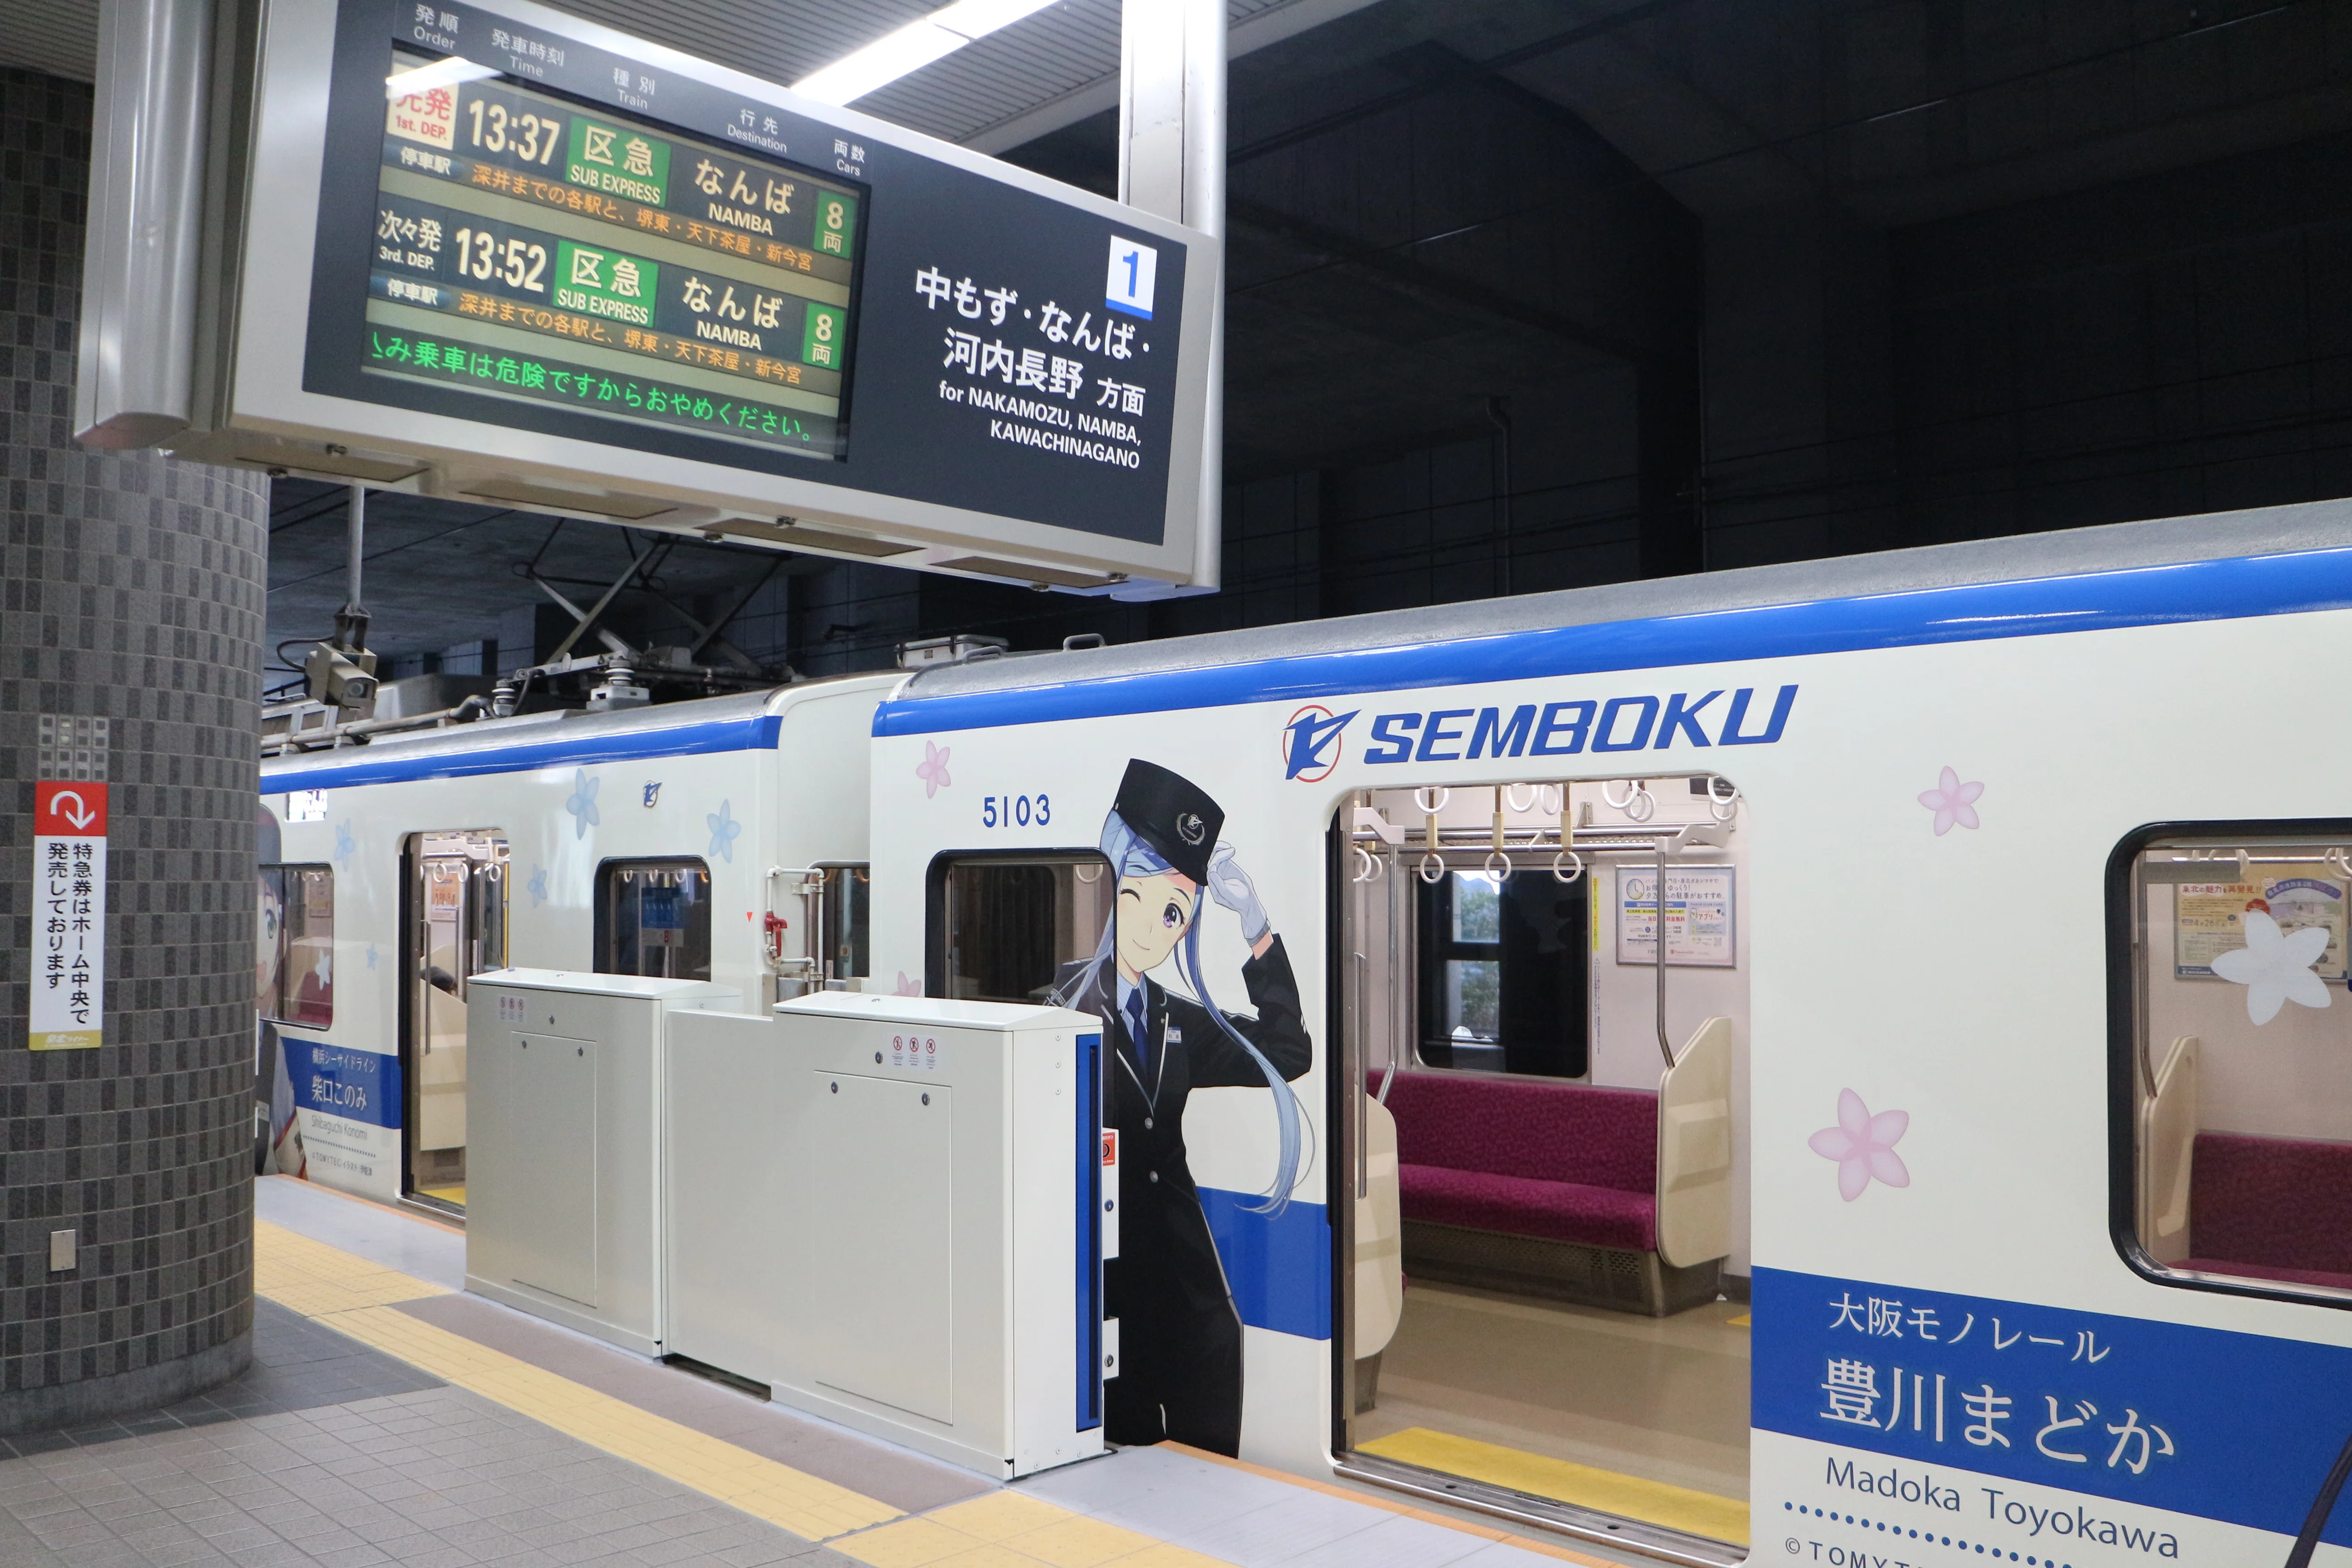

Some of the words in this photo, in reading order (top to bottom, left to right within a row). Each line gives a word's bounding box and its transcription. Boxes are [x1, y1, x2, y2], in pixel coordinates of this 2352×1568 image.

[415, 4, 458, 34] 発順
[414, 26, 455, 50] Order
[491, 29, 564, 67] 発車時刻
[510, 54, 544, 76] Time
[618, 90, 647, 110] Train
[396, 115, 416, 132] 1st.
[421, 120, 447, 141] DEP.
[469, 99, 560, 165] 13:37
[727, 124, 787, 153] Destination
[401, 146, 451, 175] 停車駅
[584, 126, 654, 177] 区急
[834, 139, 865, 164] 両数
[837, 159, 860, 176] Cars
[570, 165, 598, 188] SUB
[602, 174, 661, 205] EXPRESS
[694, 159, 794, 214] なんば
[378, 209, 442, 252] 次々発
[708, 202, 773, 236] NAMBA
[826, 202, 843, 229] 8
[379, 245, 404, 264] 3rd.
[408, 251, 435, 271] DEP.
[823, 231, 843, 253] 両
[456, 228, 546, 293] 13:52
[571, 248, 641, 298] 区急
[1122, 250, 1139, 299] 1
[387, 278, 437, 305] 停車駅
[558, 290, 586, 310] SUB
[589, 296, 649, 325] EXPRESS
[683, 276, 783, 329] なんば
[696, 320, 762, 351] NAMBA
[815, 314, 833, 342] 8
[812, 343, 832, 365] 両
[943, 327, 1084, 400] 河内長野
[1097, 377, 1146, 417] 方面
[939, 380, 964, 403] for
[968, 386, 1073, 431] NAKAMOZU,
[1078, 412, 1141, 446] NAMBA,
[990, 419, 1140, 469] KAWACHINAGANO
[1363, 684, 1799, 765] SEMBOKU
[983, 794, 1051, 828] 5103
[46, 843, 69, 990] 発売しております
[70, 842, 93, 1024] 特急券はホーム中央で
[312, 1074, 367, 1111] 柴口このみ
[312, 1115, 343, 1134] Shibaguchi
[344, 1122, 368, 1140] Konomi
[1828, 1293, 2111, 1364] 大阪モノレール
[1819, 1357, 2176, 1475] 豊川まどか
[1826, 1457, 1961, 1513] Madoka
[1981, 1487, 2179, 1560] Toyokawa
